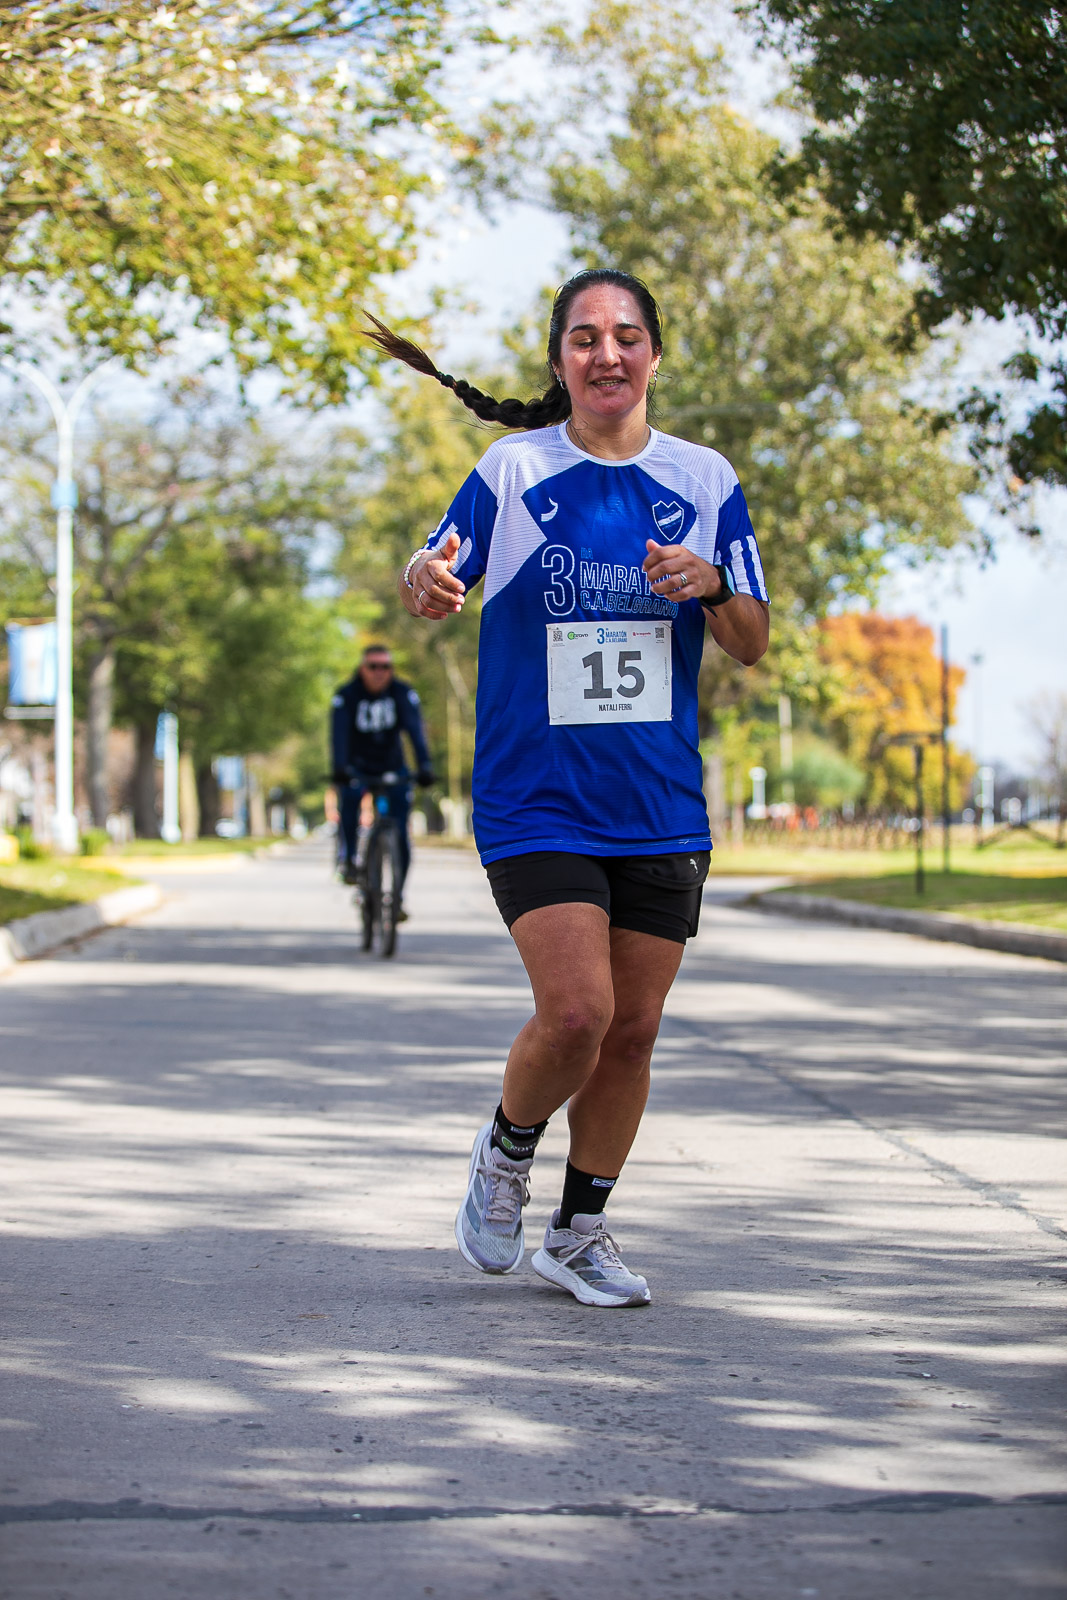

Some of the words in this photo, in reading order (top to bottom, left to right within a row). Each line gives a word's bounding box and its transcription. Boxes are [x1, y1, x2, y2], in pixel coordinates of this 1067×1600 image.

[541, 544, 576, 616] 3
[580, 561, 682, 598] MARAT
[596, 627, 605, 645] 3
[582, 650, 646, 700] 15
[598, 703, 618, 712] NATALI
